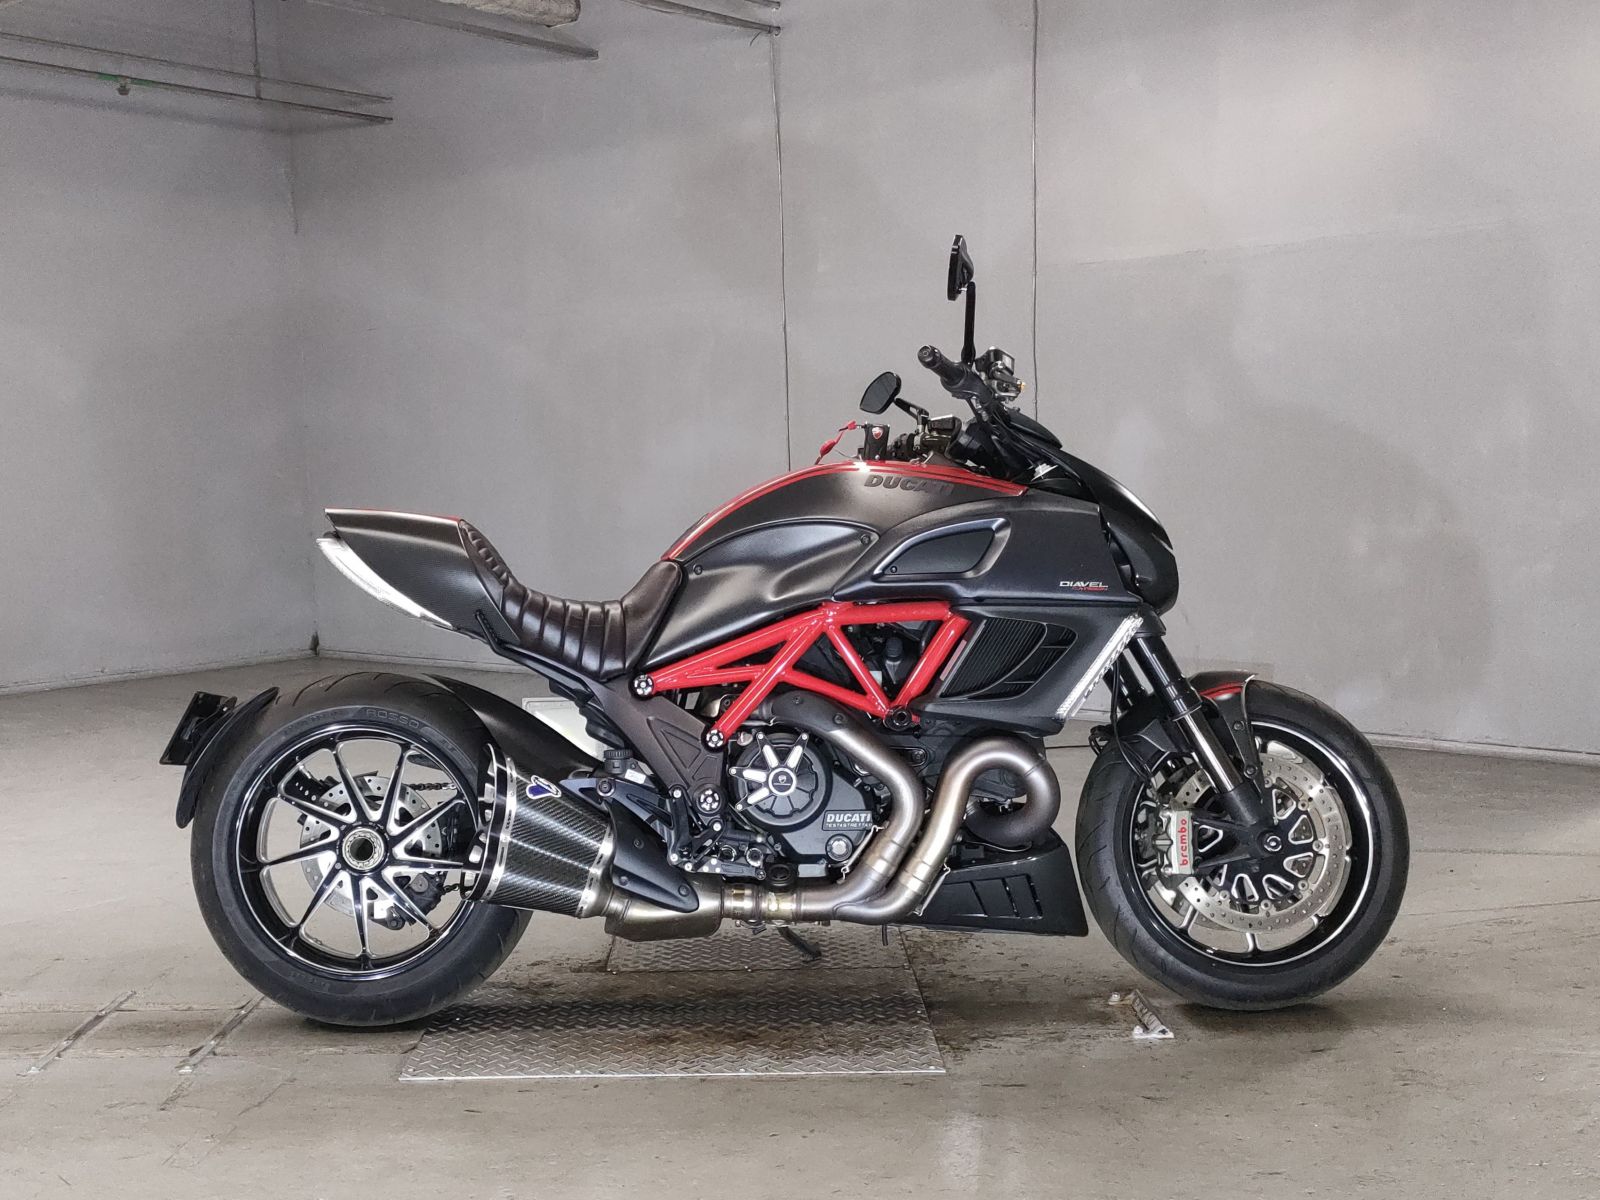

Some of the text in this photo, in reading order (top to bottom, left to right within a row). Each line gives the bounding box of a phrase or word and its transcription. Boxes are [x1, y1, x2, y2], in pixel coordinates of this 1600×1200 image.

[367, 708, 419, 729] ROSSO
[826, 813, 872, 822] DUCATI
[1178, 819, 1189, 866] brembo
